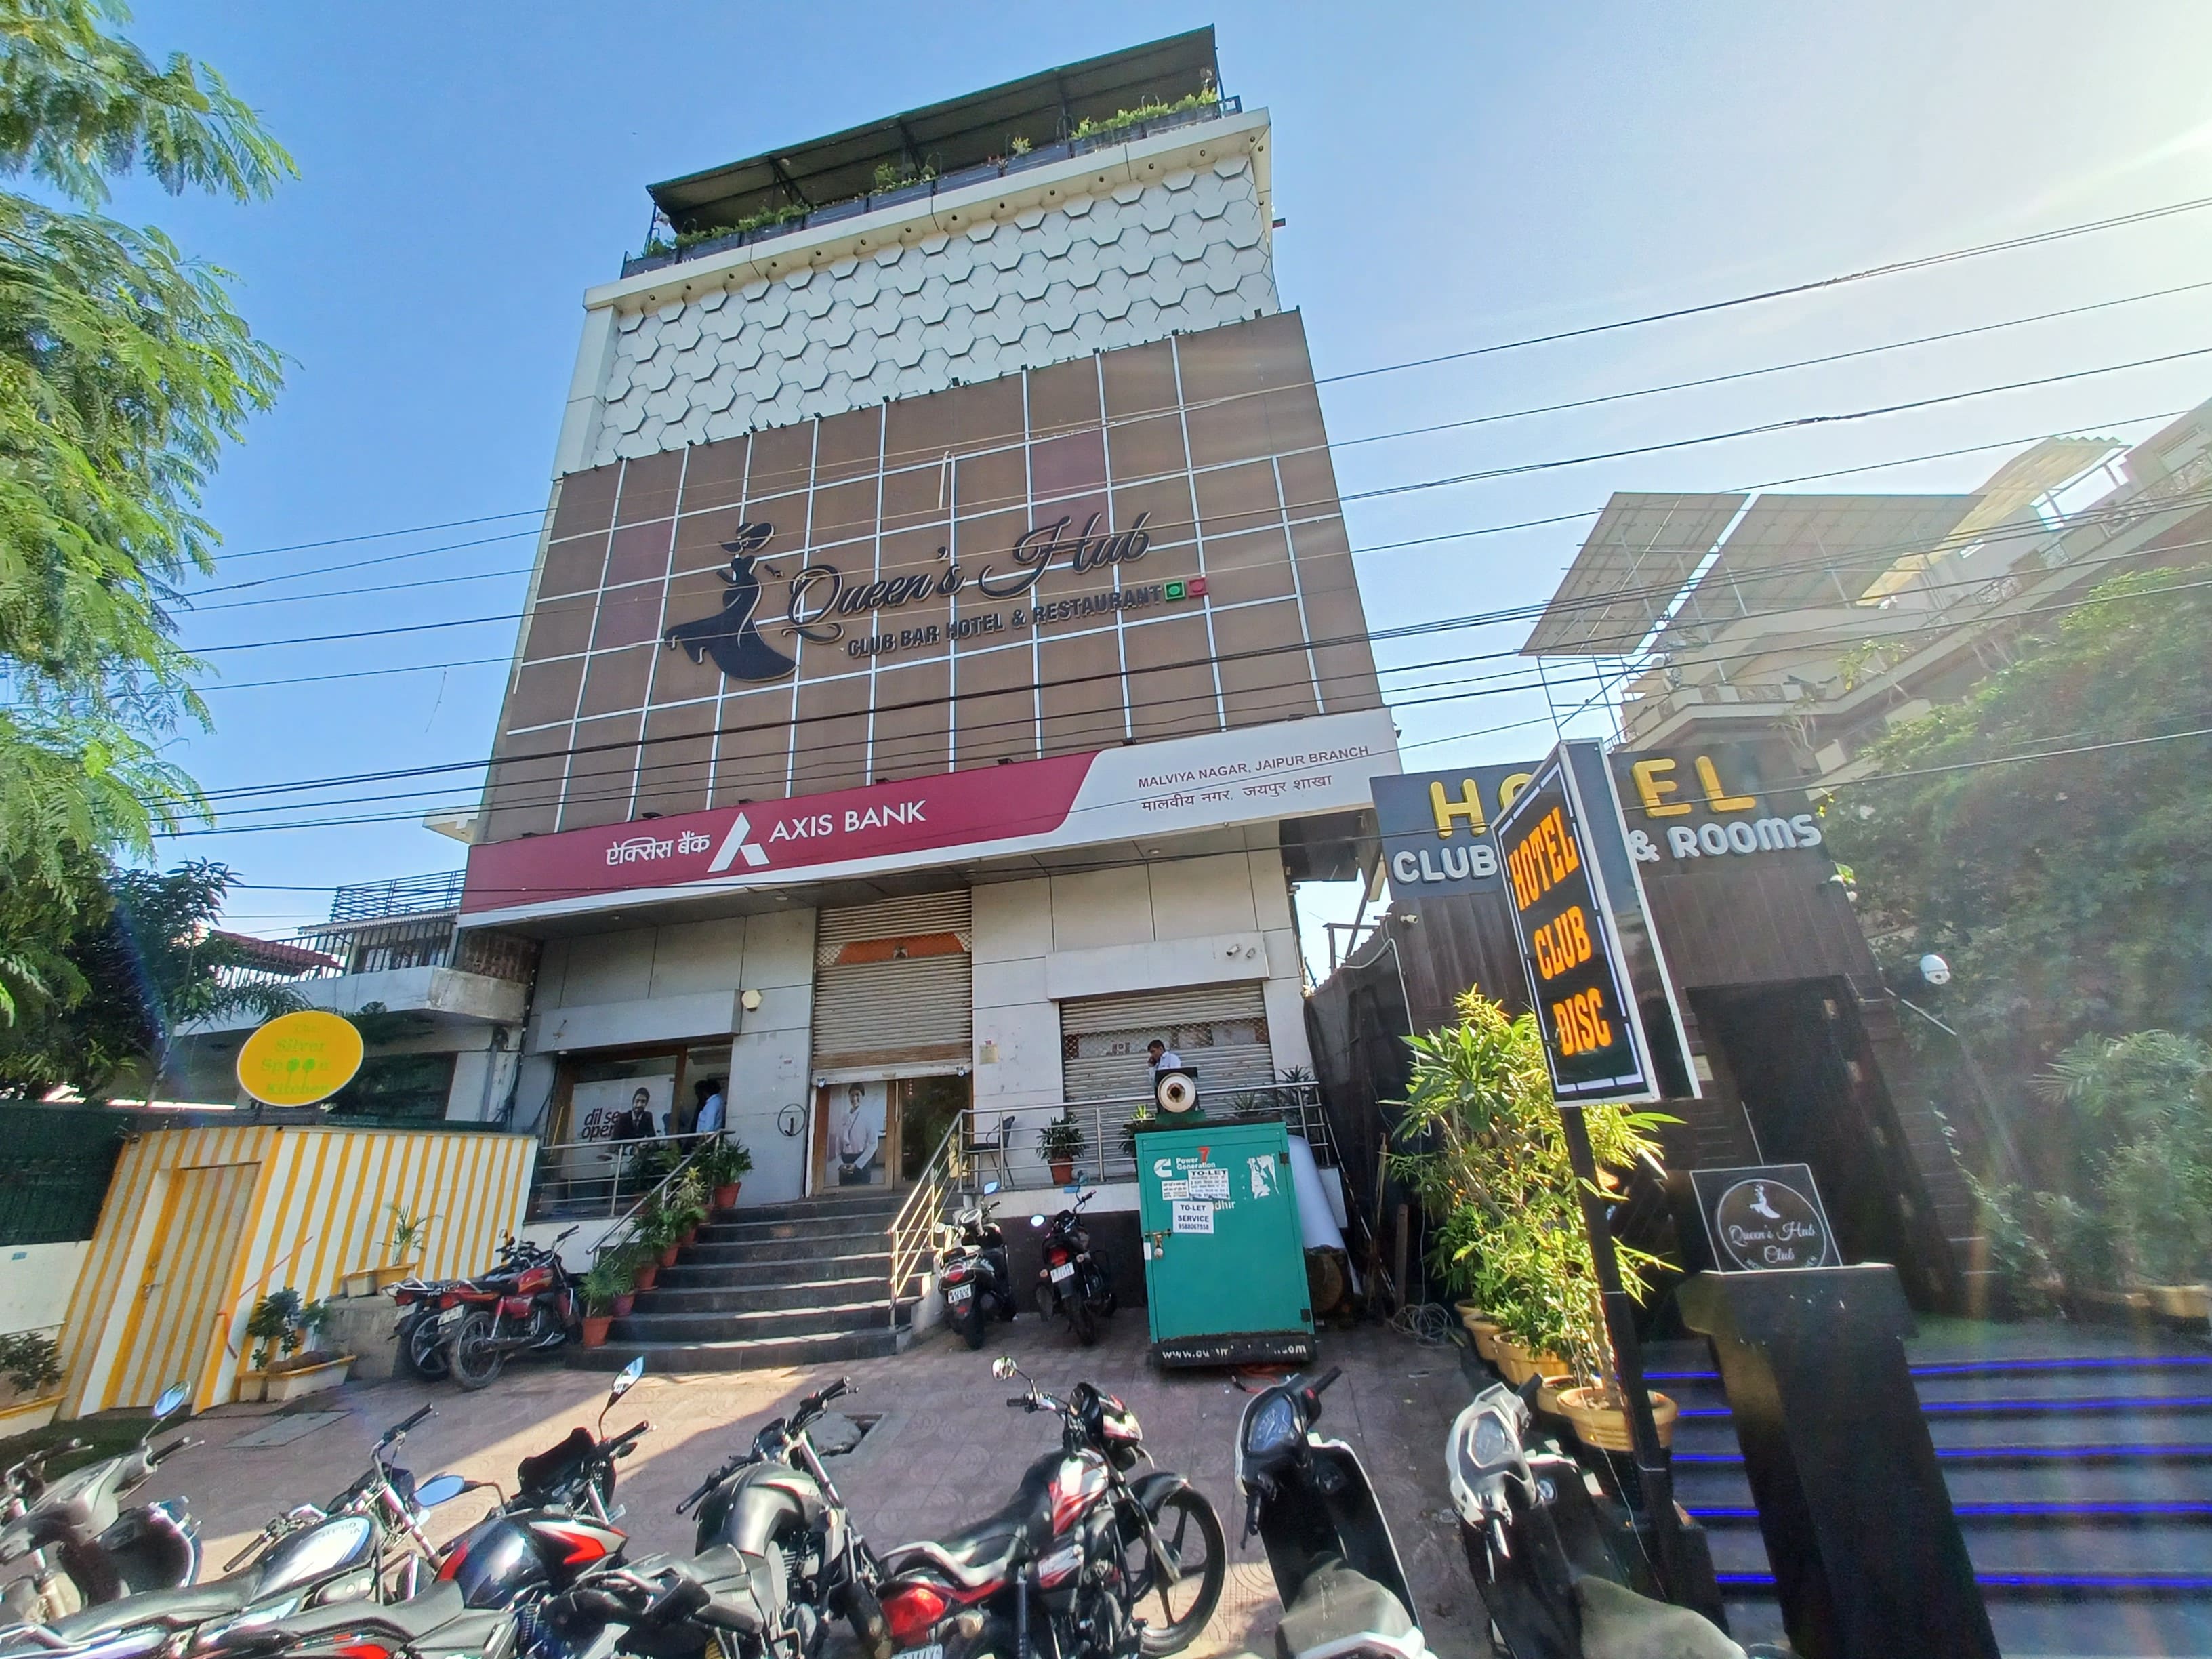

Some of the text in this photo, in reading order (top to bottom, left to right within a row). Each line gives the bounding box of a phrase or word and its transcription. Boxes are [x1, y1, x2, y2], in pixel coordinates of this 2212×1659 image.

[781, 511, 1151, 644] Queen's Hub
[848, 584, 1162, 659] CLUB BAR HOTEL & RESTAURANT
[1138, 745, 1370, 789] MALVIYA NAGAR, JAIPUR BRANCH
[1141, 793, 1195, 812] मालवीय
[1242, 781, 1286, 798] जयपुर
[1293, 775, 1332, 790] शाखा
[1429, 756, 1757, 840] HEL
[678, 830, 710, 855] बैंक
[768, 799, 926, 843] AXIS BANK
[1393, 814, 1822, 884] CLUB & ROOMS
[1508, 806, 1580, 912] HOTEL
[1534, 905, 1592, 981] CLUB
[1553, 987, 1612, 1057] DISC
[584, 1107, 619, 1126] dil se
[1176, 1162, 1216, 1170] Generation
[1729, 1221, 1816, 1247] Queen's Hub
[1763, 1245, 1795, 1264] Club
